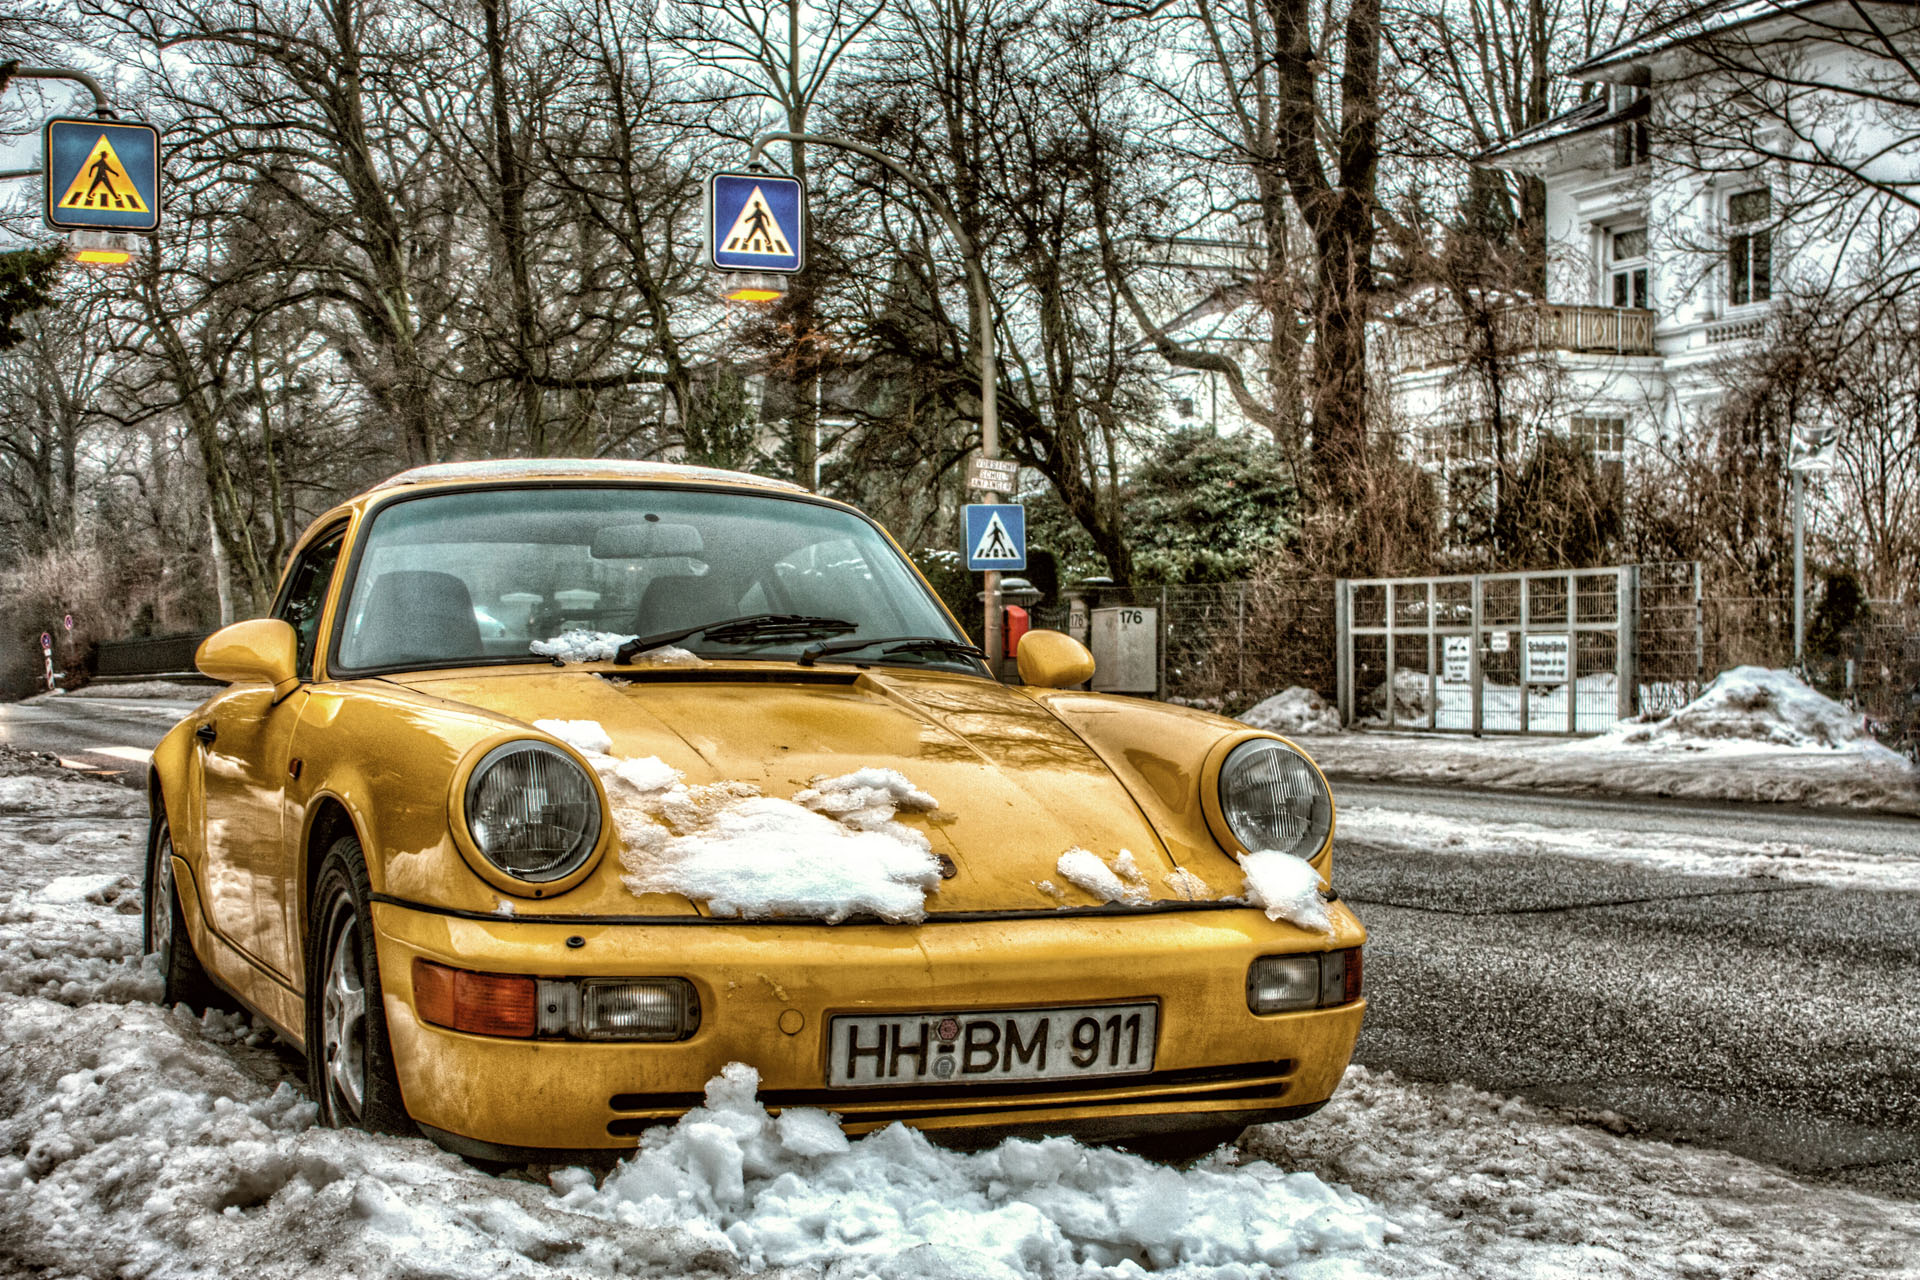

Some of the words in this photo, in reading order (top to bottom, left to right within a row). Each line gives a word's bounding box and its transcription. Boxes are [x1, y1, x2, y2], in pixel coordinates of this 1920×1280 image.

[977, 459, 1016, 472] VORSICHT
[1070, 614, 1084, 627] 176
[1120, 610, 1143, 625] 176
[1071, 1013, 1141, 1068] 911
